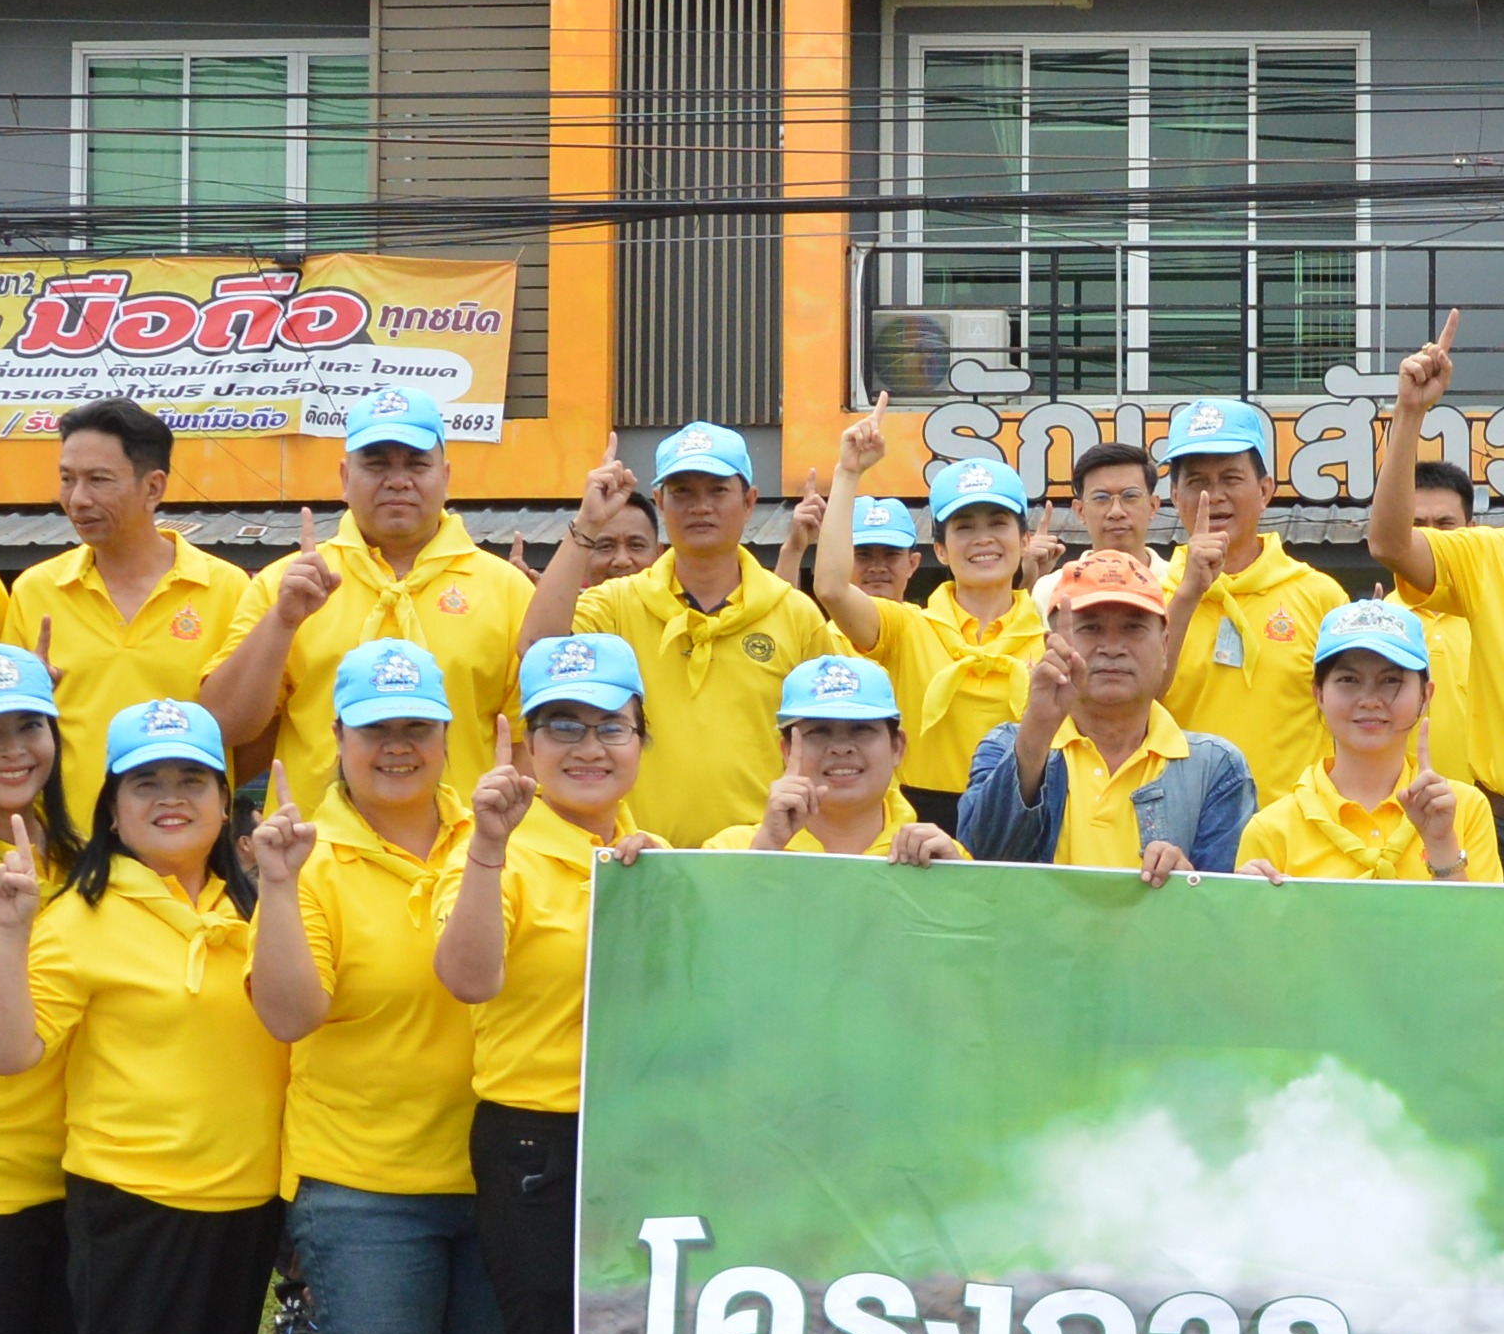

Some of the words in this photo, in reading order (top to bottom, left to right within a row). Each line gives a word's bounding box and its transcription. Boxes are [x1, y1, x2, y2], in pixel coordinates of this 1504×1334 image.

[12, 269, 373, 359] มือถือ
[377, 300, 503, 340] ทุกชนิด
[318, 359, 363, 375] และ
[212, 377, 393, 398] ปลดล็อครหั
[438, 412, 494, 432] -8693
